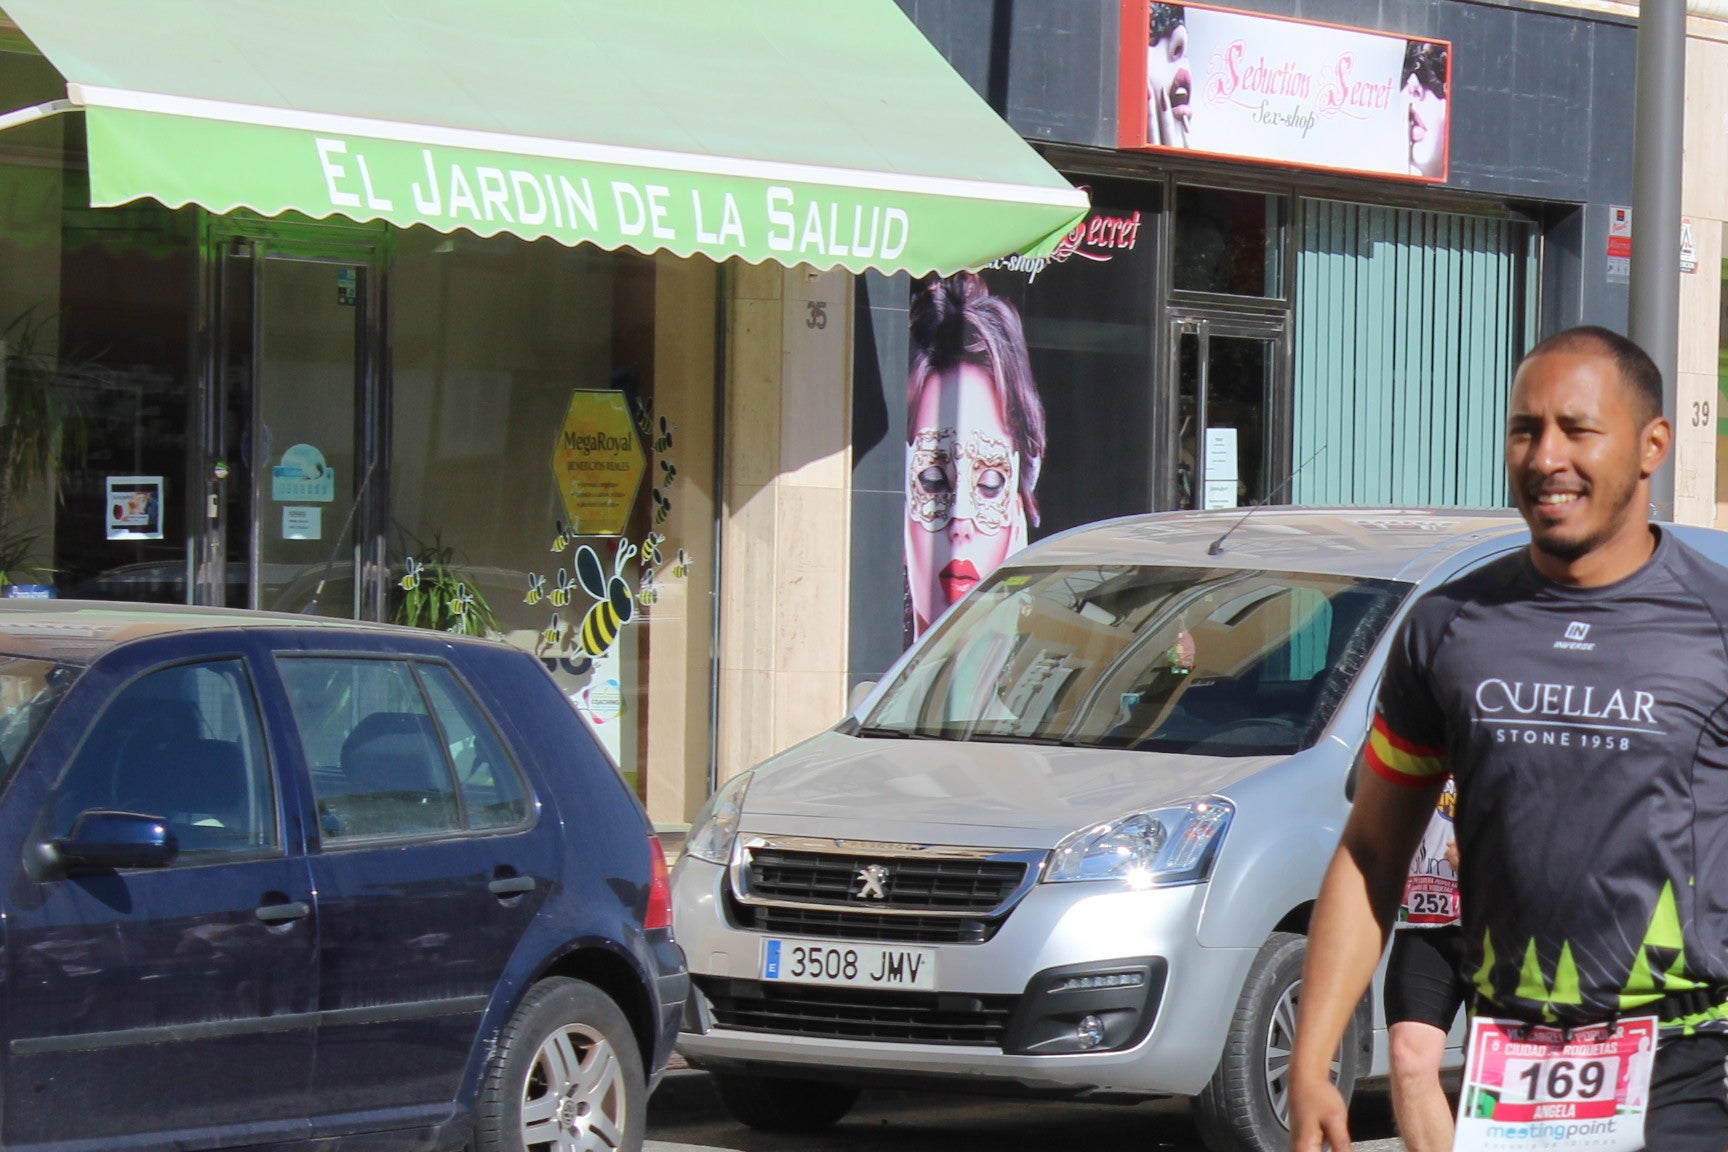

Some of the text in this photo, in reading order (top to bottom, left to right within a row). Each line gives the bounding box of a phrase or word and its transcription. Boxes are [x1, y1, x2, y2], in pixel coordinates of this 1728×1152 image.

[1208, 41, 1393, 110] Seduction Secret
[1253, 99, 1315, 139] Sex-shop
[315, 137, 908, 260] EL JARDIN DE LA SALUD
[806, 301, 827, 330] 35
[1692, 401, 1710, 427] 39
[565, 432, 632, 456] MegaRoyal
[1553, 640, 1596, 651] INVERSE
[1475, 678, 1657, 724] CUELLAR
[1497, 729, 1629, 750] STONE 1958
[1413, 893, 1449, 915] 252
[769, 947, 922, 983] E 3508 JMV
[1505, 1043, 1547, 1056] CIUDAD
[1563, 1042, 1618, 1056] ROQUETAS
[1520, 1061, 1605, 1101] 169
[1534, 1104, 1576, 1119] ANGELA
[1487, 1119, 1616, 1140] meetingpoint
